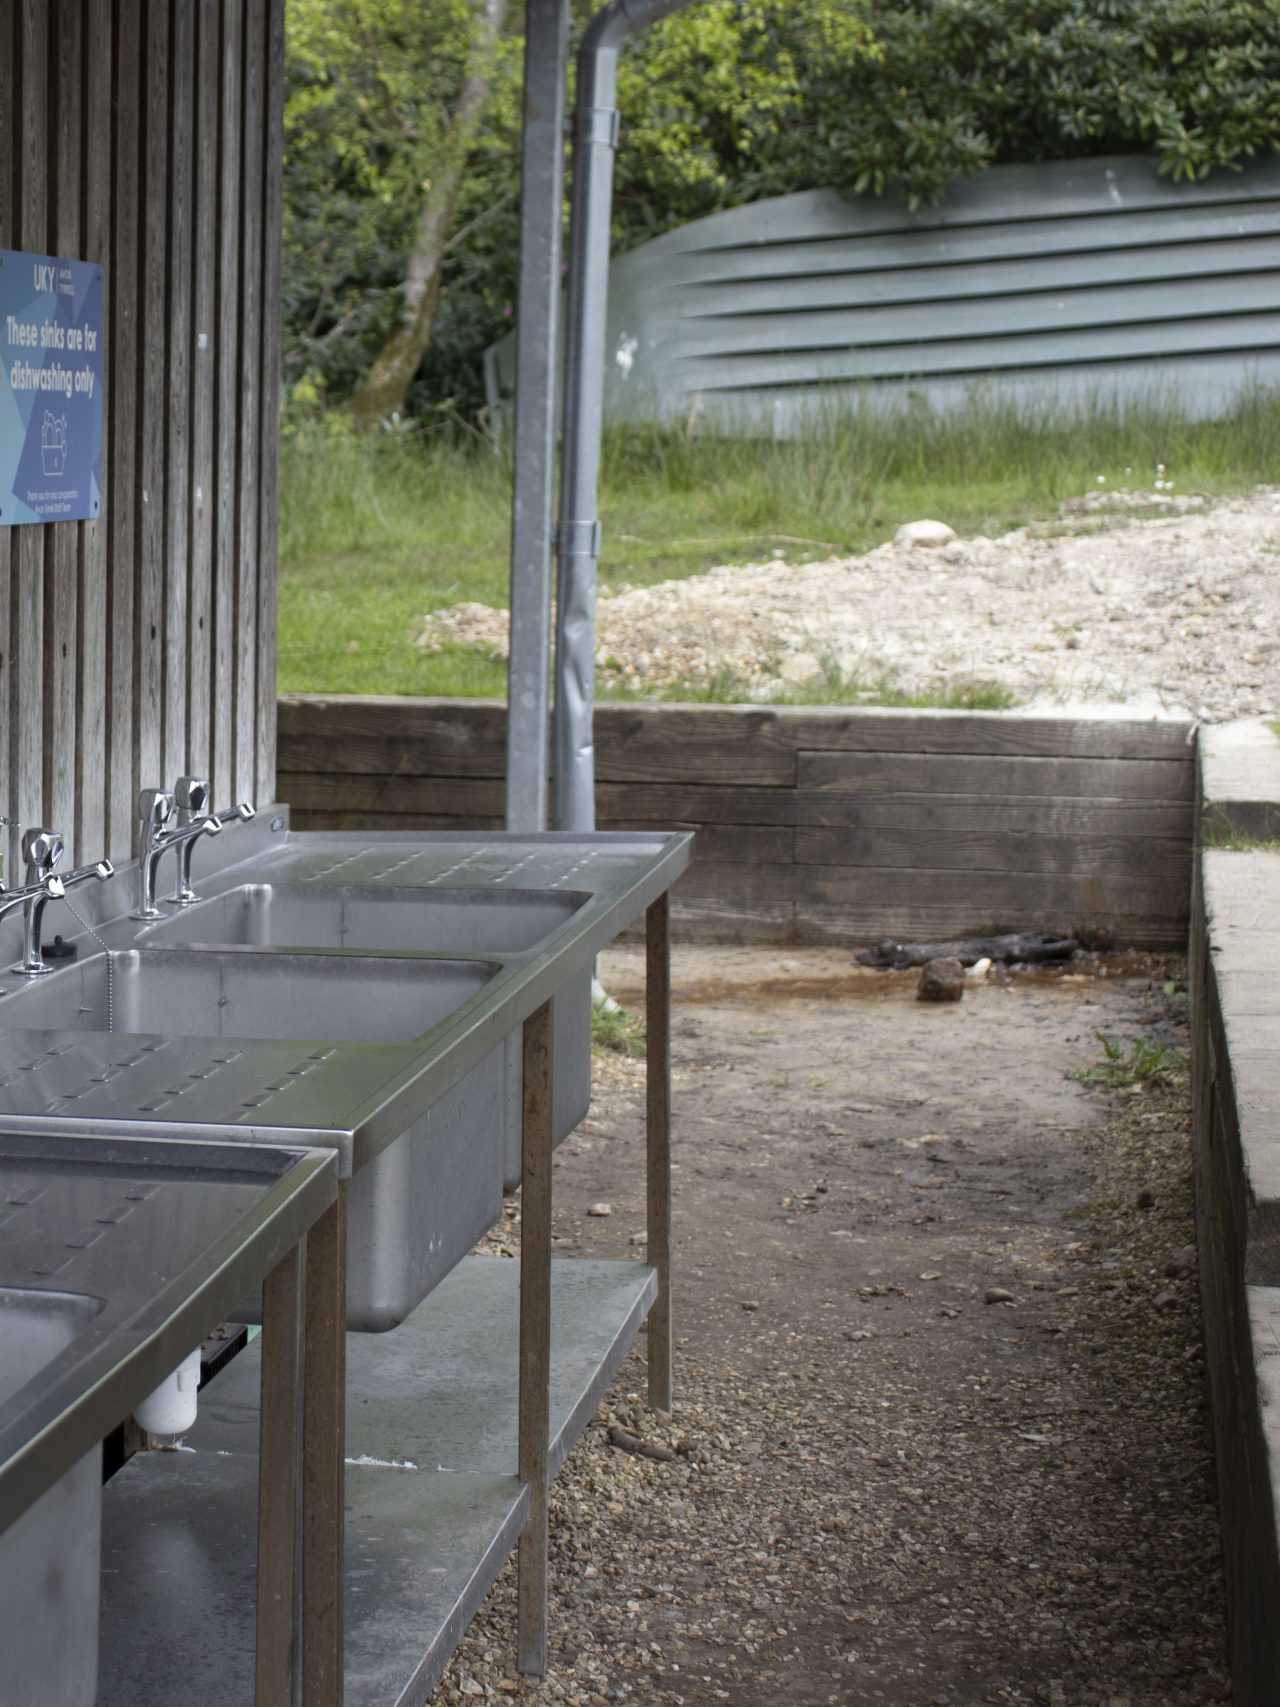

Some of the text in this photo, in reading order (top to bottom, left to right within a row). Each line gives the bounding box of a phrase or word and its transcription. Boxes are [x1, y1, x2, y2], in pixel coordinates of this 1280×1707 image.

[33, 264, 55, 292] UKY
[6, 315, 97, 351] These sinks are for
[10, 360, 95, 399] dishwashing only
